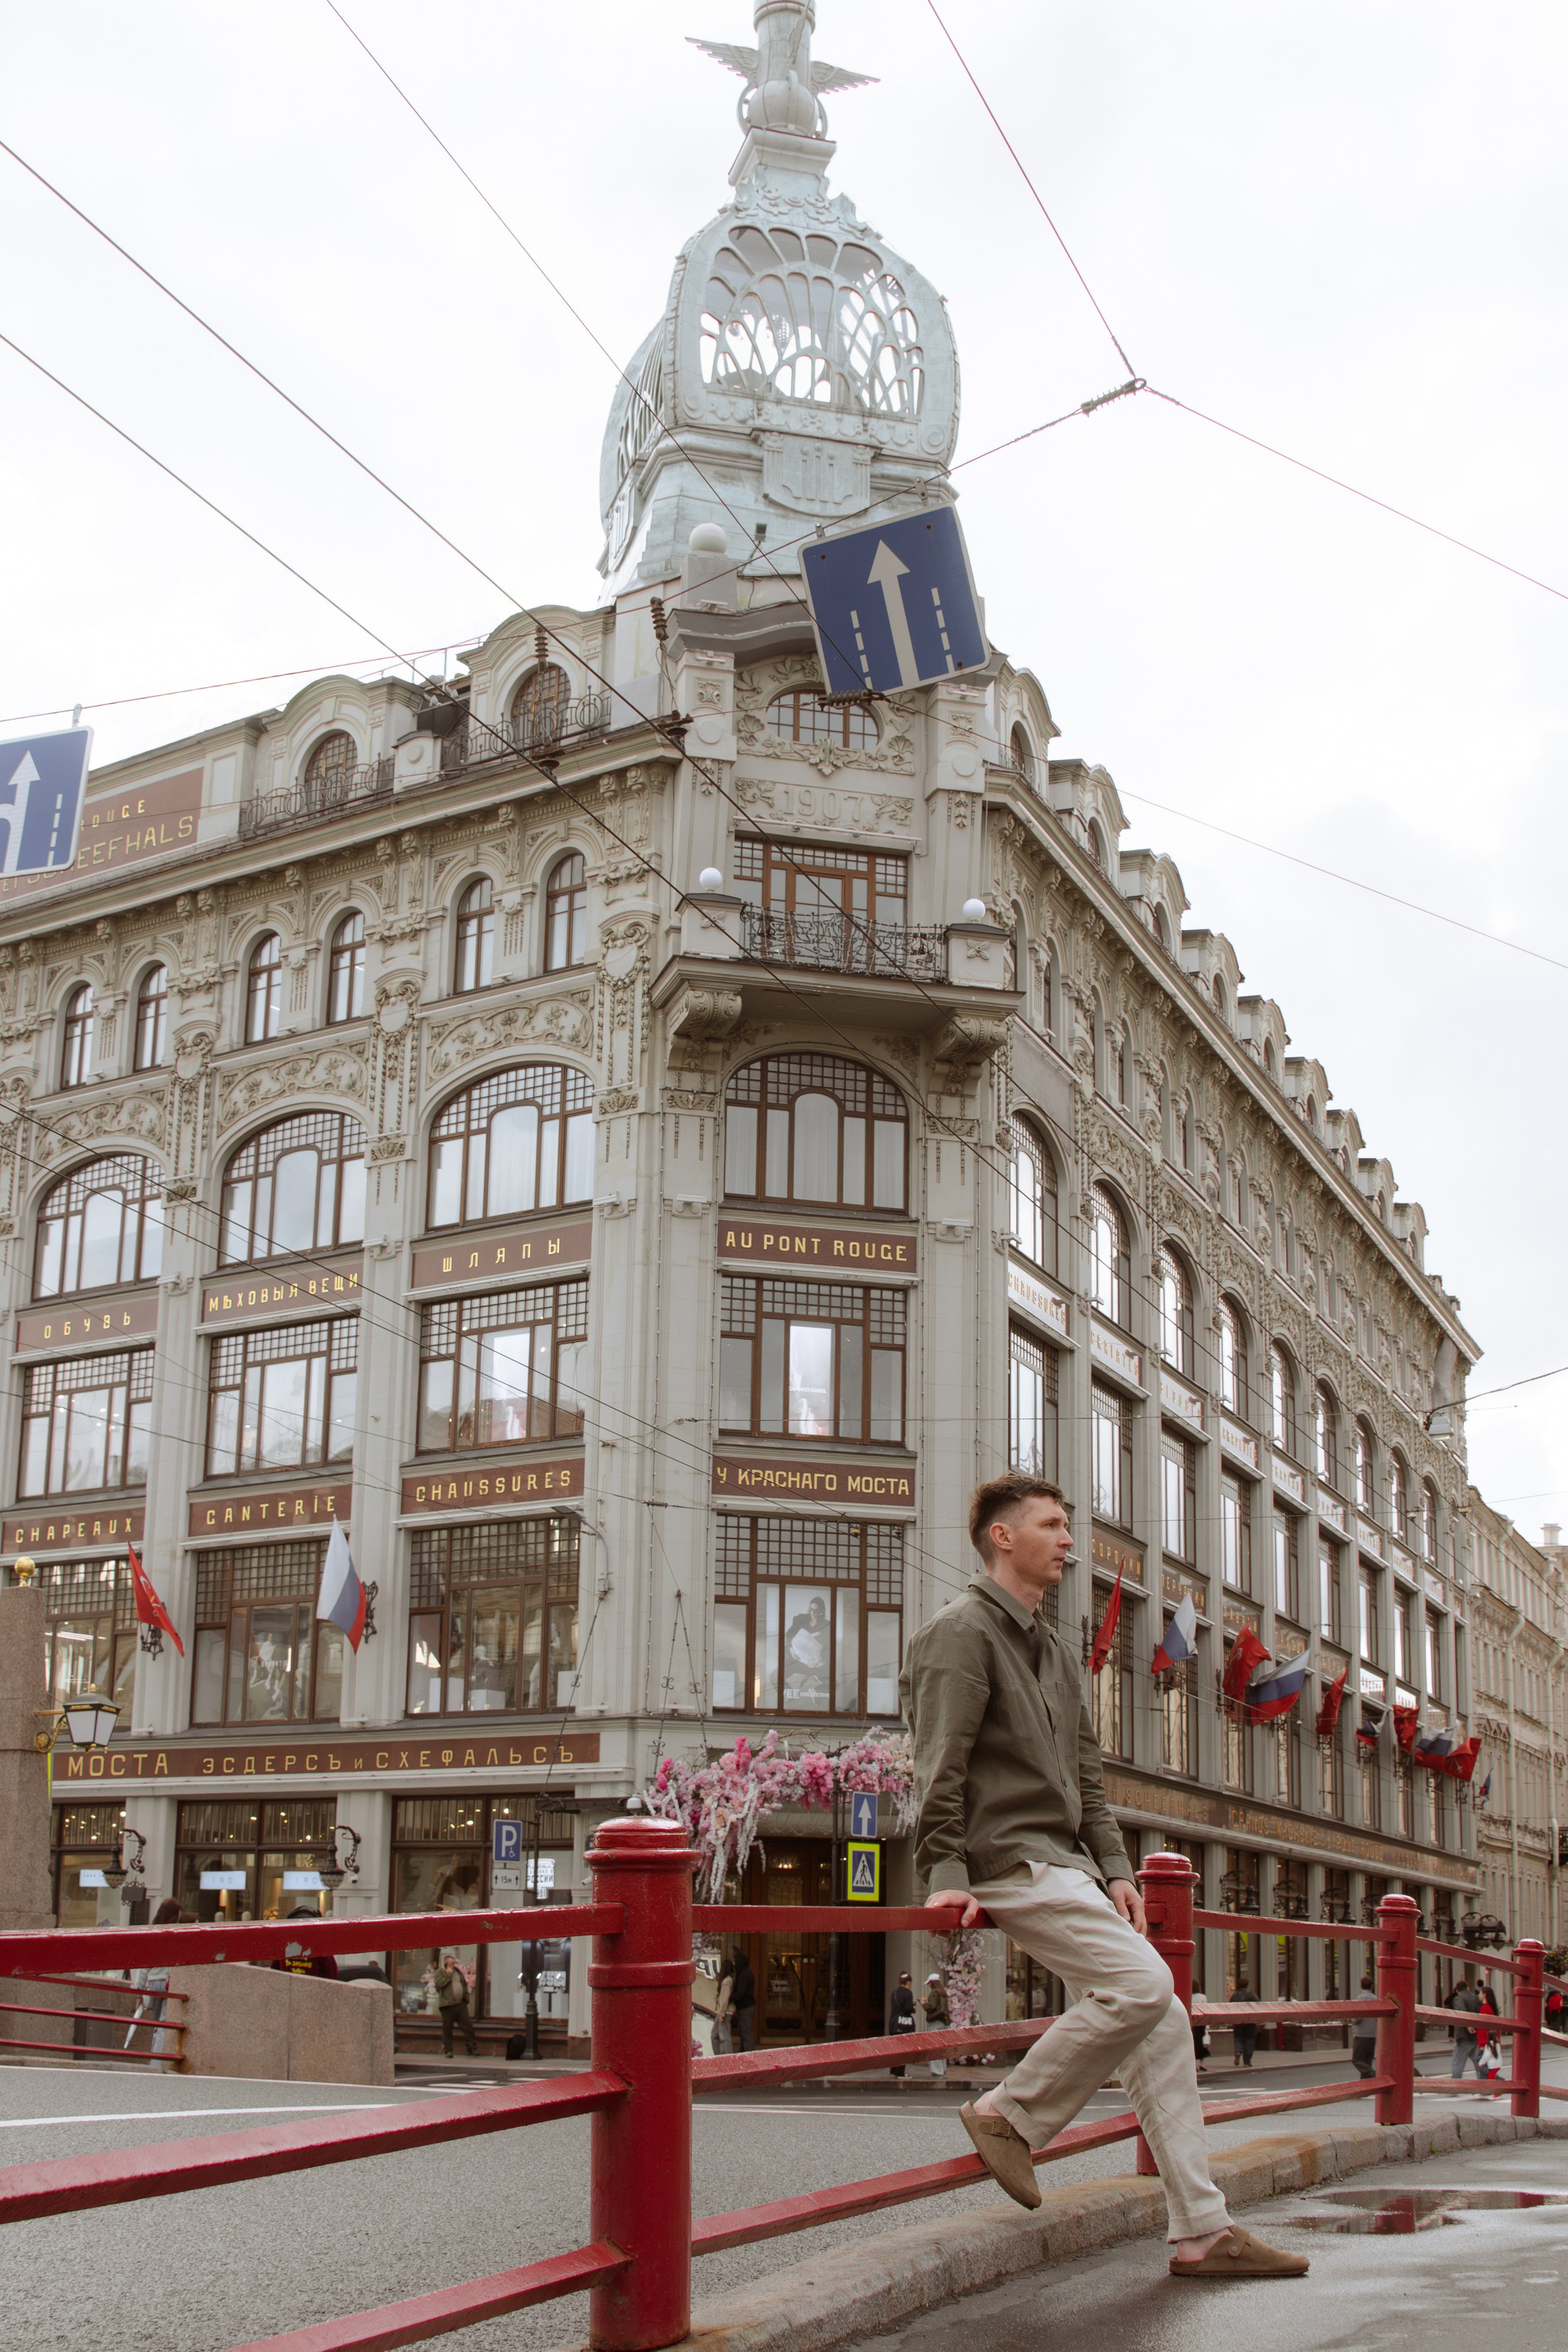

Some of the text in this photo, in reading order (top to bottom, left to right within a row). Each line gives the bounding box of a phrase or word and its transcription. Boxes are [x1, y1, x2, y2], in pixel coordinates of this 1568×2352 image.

[783, 786, 865, 822] 1907
[28, 816, 194, 884] EEFHALS
[442, 1238, 560, 1273] ШЛЯПЫ
[726, 1231, 907, 1262] AU PONT ROUGE
[309, 1272, 358, 1295] ВЕЩИ
[43, 1311, 131, 1339] ОБУВЬ
[416, 1470, 571, 1502] CHAUSSURES
[717, 1467, 910, 1496] У КРАСНАГО МОСТА
[15, 1517, 132, 1544] CHAPEAUX
[68, 1752, 168, 1776] МОСТА
[203, 1754, 341, 1774] ЭСДЕРСЪ
[376, 1746, 573, 1769] СХЕФАЛЬСЪ
[1126, 1788, 1208, 1821] SCHEEFHALS
[501, 1825, 517, 1858] P
